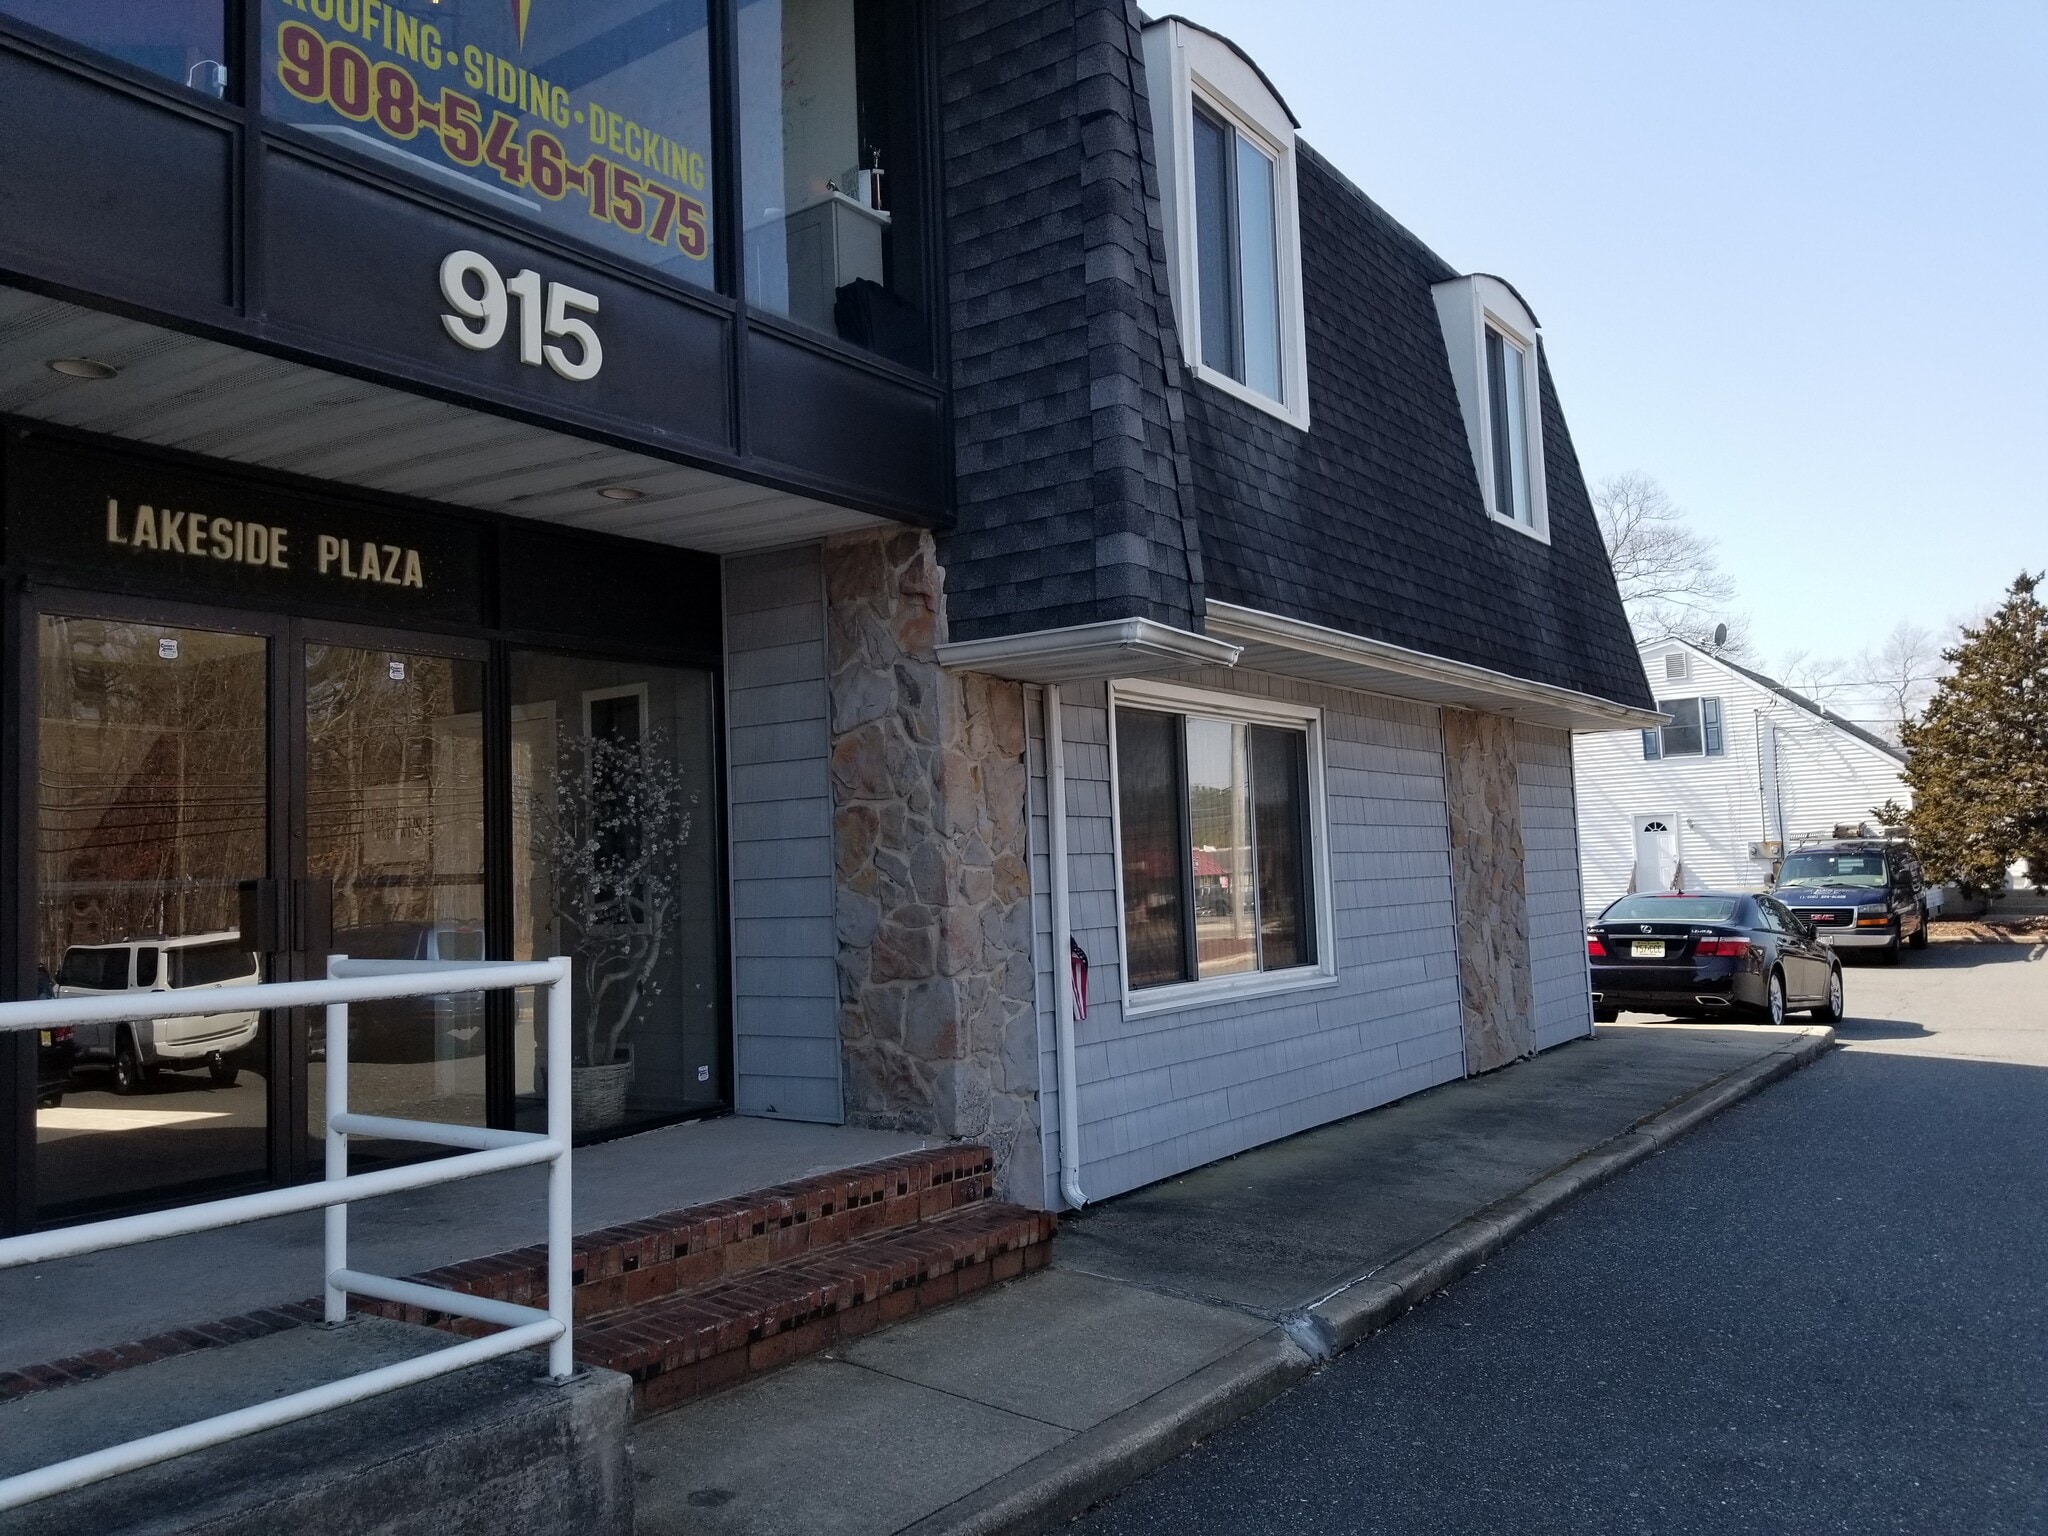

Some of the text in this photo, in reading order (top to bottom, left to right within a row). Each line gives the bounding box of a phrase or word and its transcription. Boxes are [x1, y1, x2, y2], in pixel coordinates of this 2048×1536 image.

[278, 20, 707, 260] 908-546-1575
[281, 0, 704, 190] OFING SIDING DECKING
[439, 250, 603, 381] 915
[107, 499, 423, 588] LAKESIDE PLAZA
